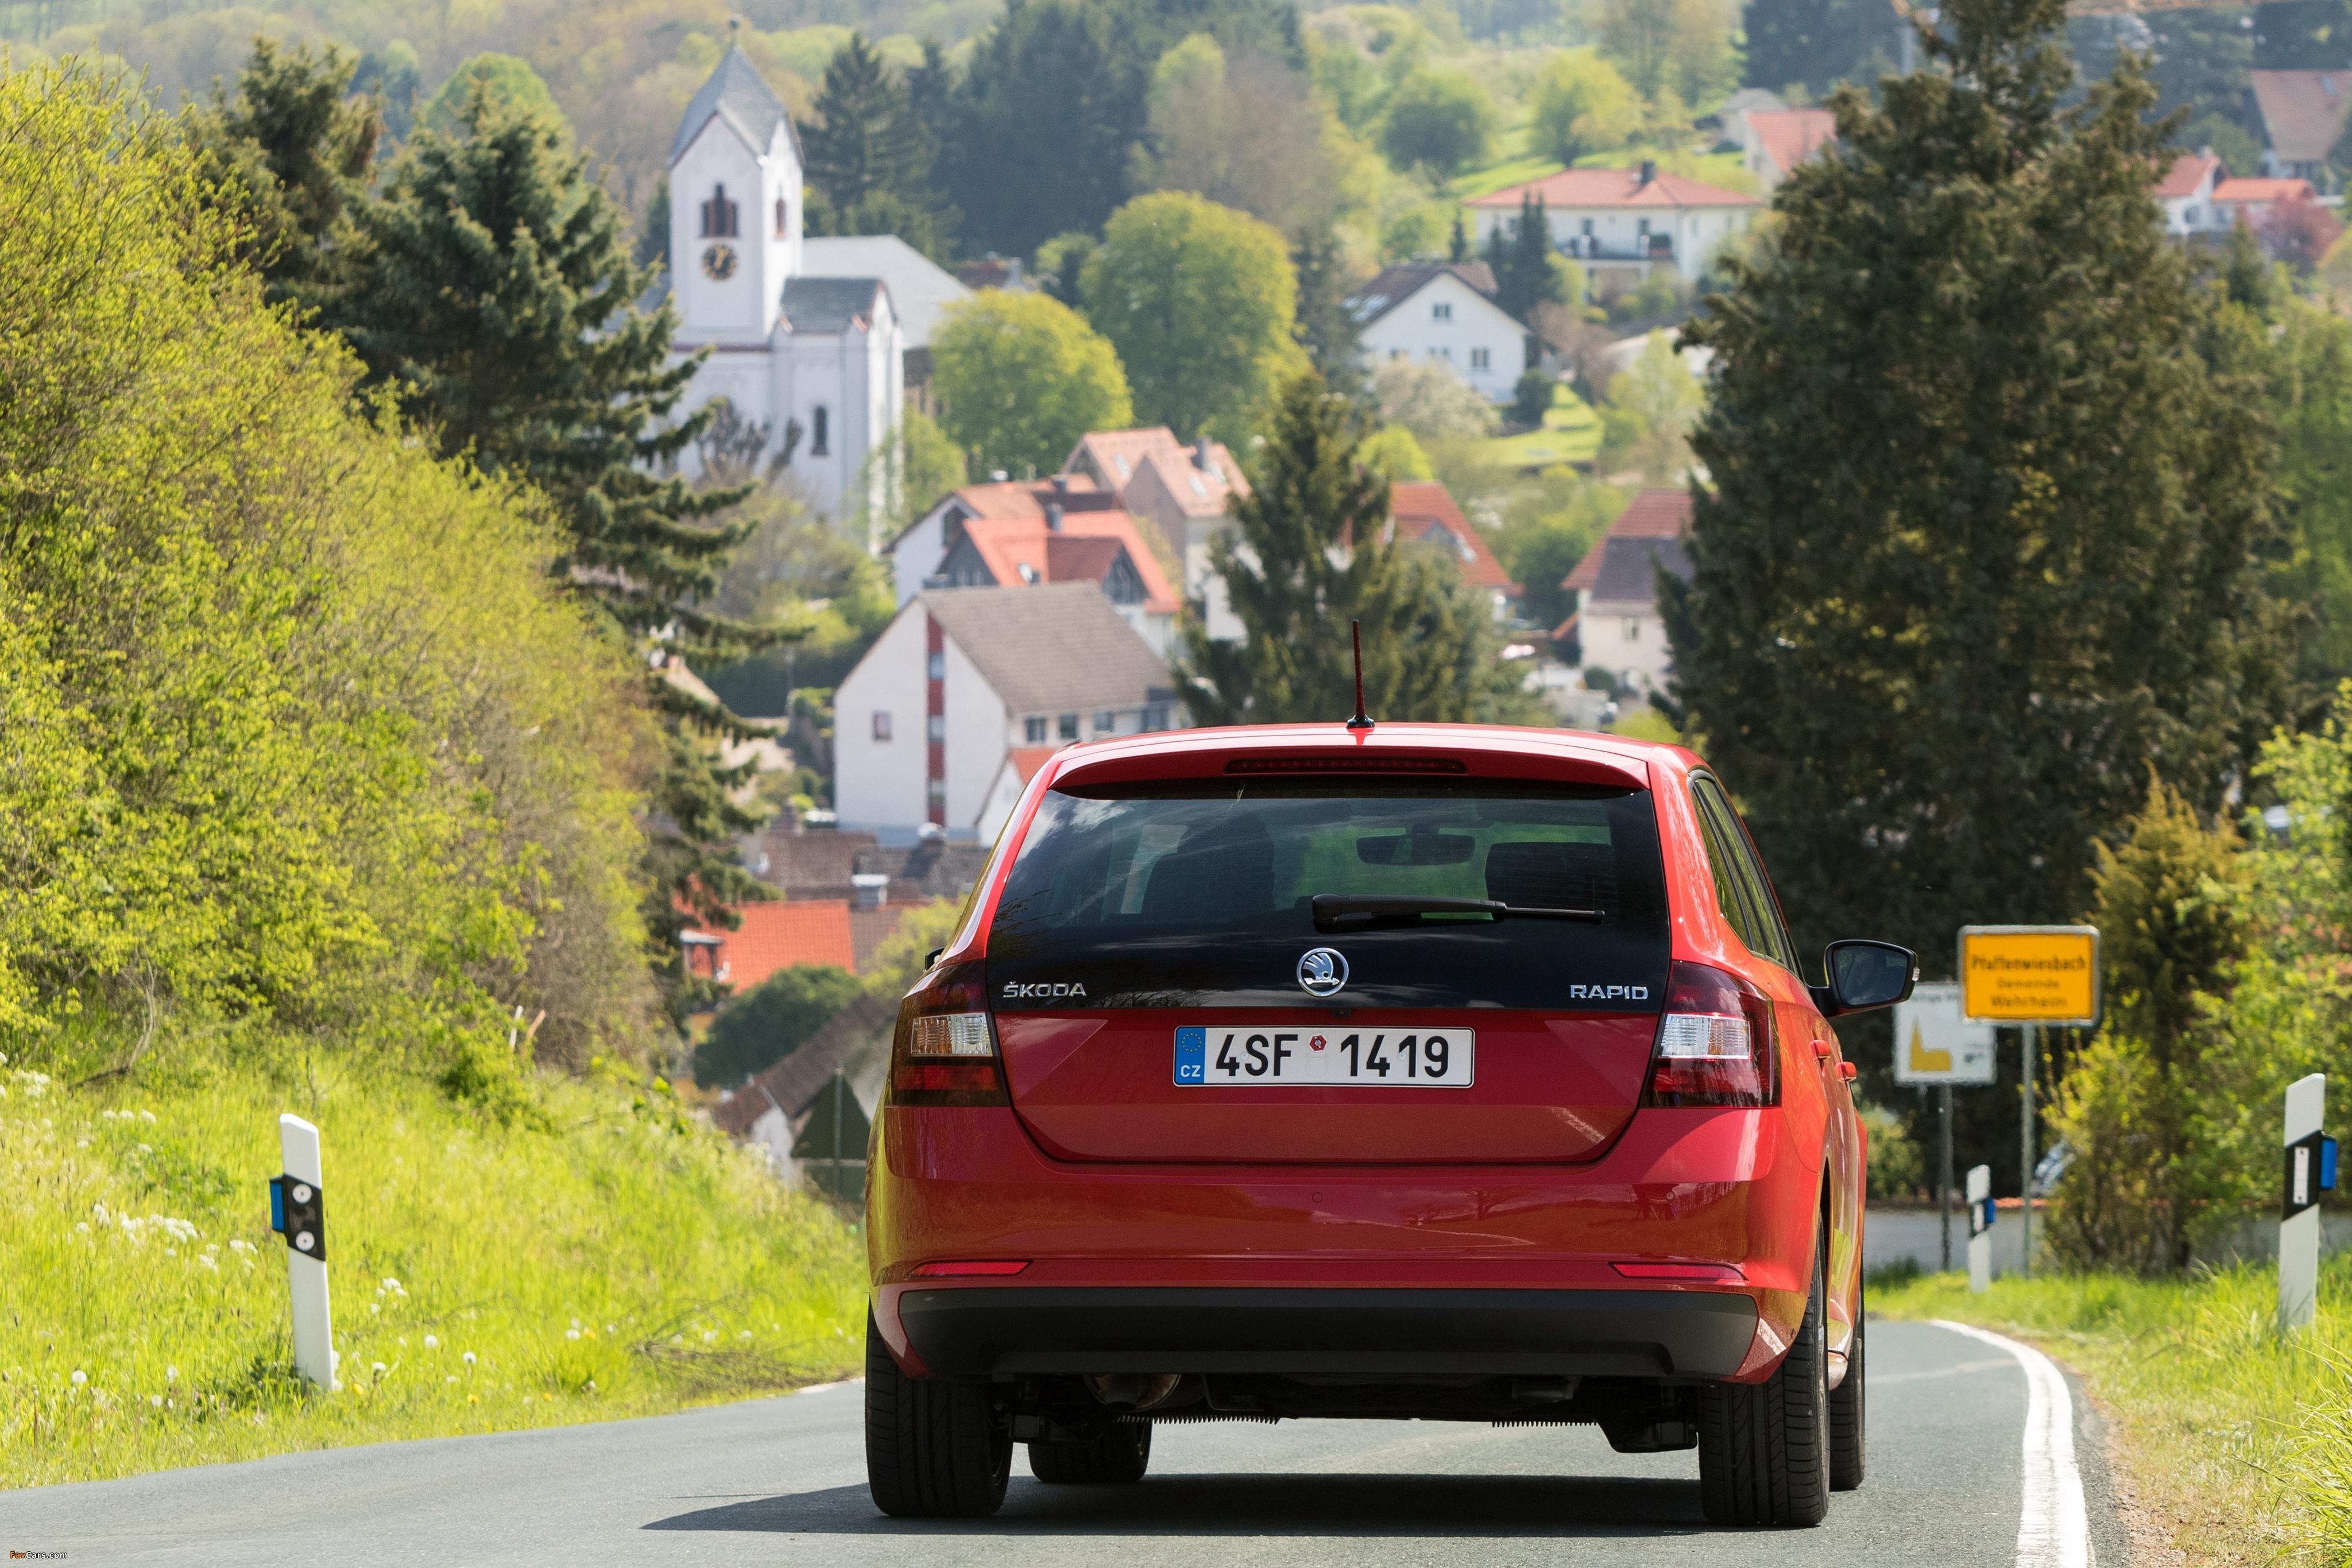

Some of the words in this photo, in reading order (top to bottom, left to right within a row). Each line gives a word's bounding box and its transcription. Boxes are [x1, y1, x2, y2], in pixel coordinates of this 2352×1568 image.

[1003, 981, 1086, 998] ŠKODA
[1570, 985, 1648, 999] RAPID
[1216, 1034, 1298, 1077] 4SF
[1340, 1035, 1449, 1078] 1419
[1180, 1064, 1201, 1077] CZ
